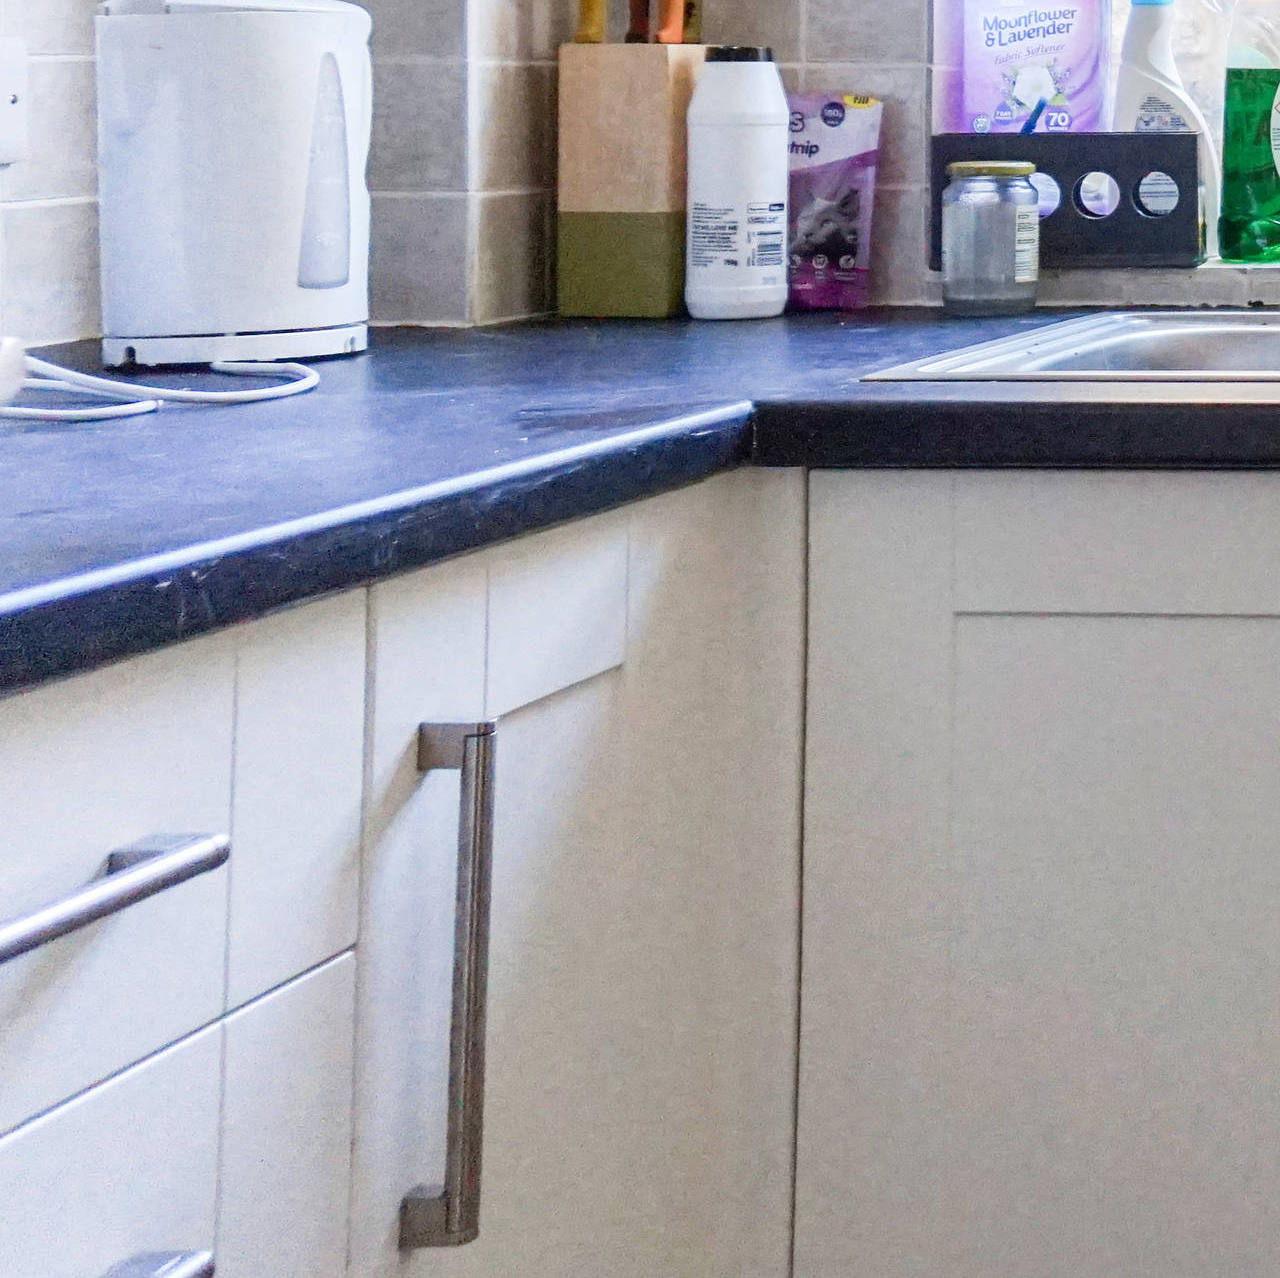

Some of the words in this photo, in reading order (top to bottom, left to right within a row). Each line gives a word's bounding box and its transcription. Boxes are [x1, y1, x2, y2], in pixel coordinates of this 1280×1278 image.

[983, 9, 1077, 32] Moonflower
[985, 31, 995, 47] &
[998, 21, 1073, 47] Lavender
[1048, 112, 1069, 126] 70
[787, 140, 820, 158] tnip
